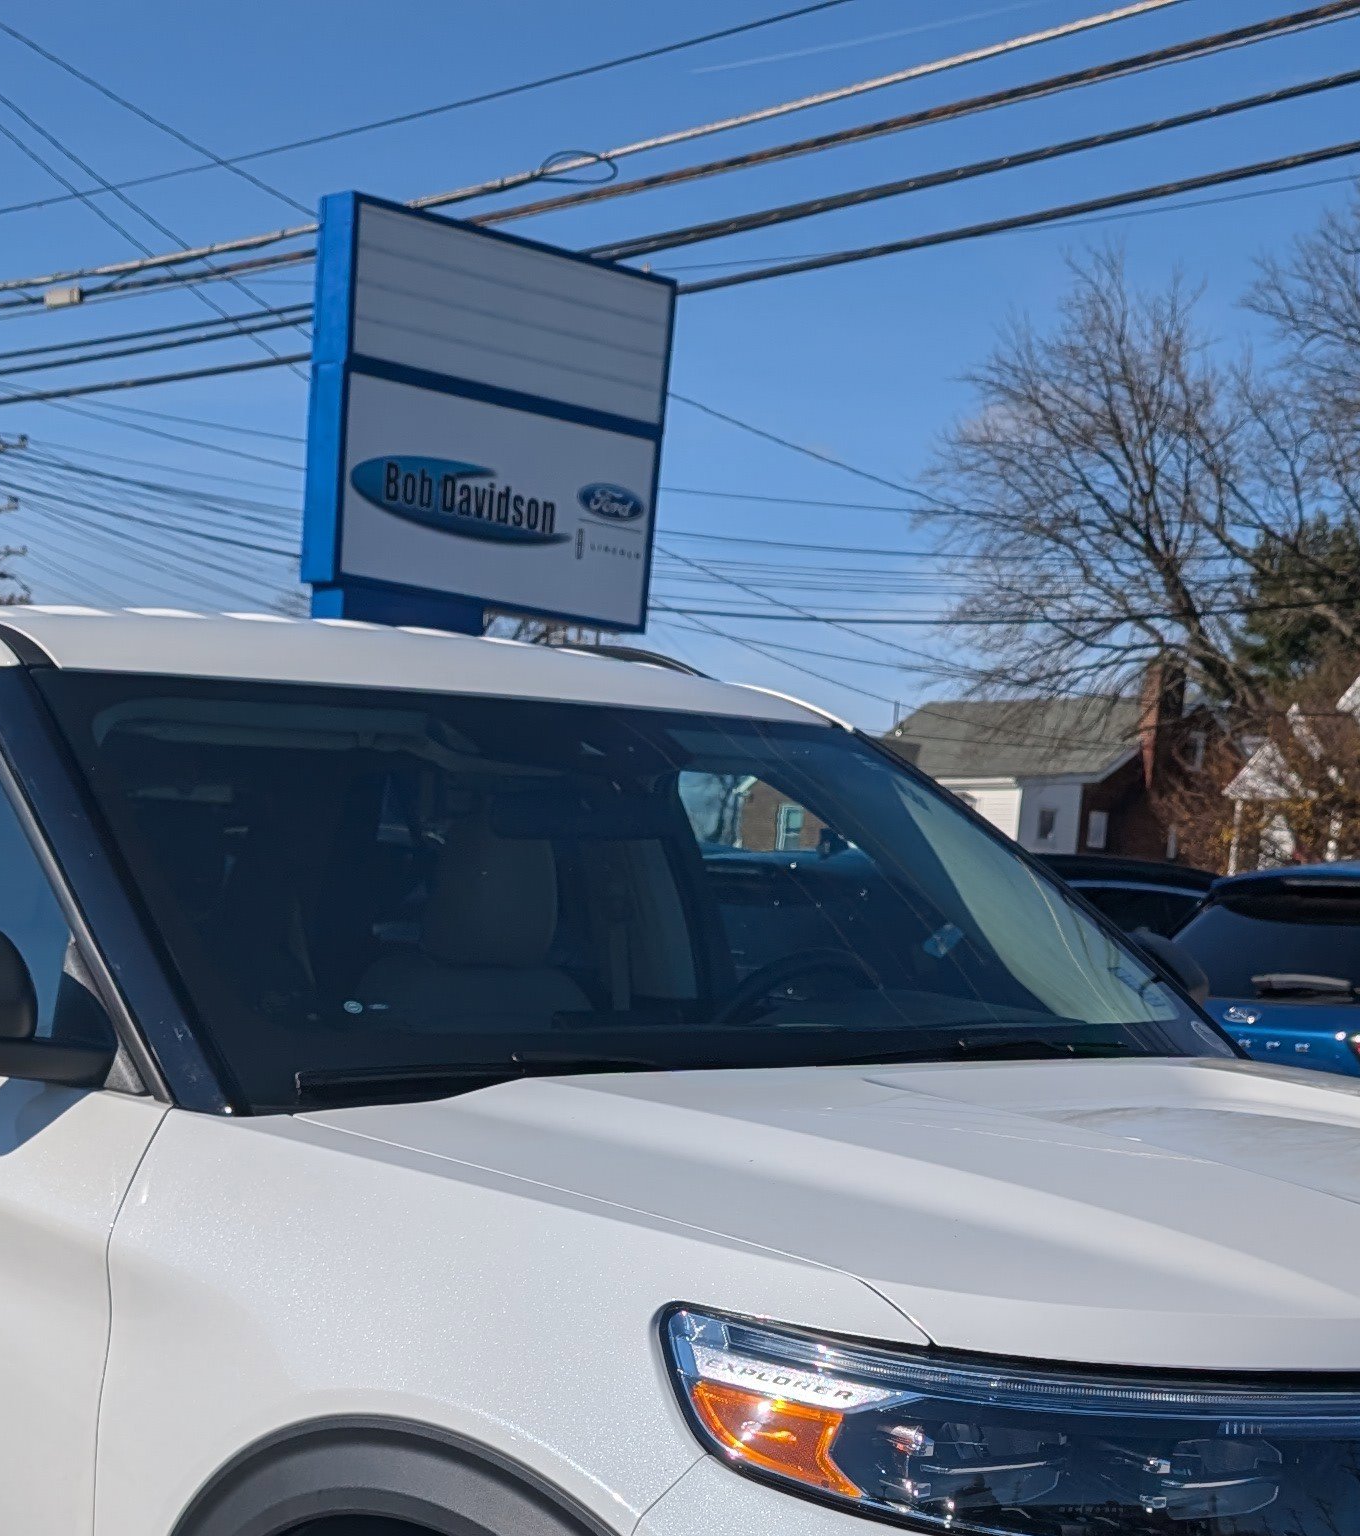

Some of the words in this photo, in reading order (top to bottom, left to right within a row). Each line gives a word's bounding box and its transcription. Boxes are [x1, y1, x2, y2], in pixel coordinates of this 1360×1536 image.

[386, 462, 433, 511] Bob
[442, 474, 556, 534] Davidson
[705, 1359, 854, 1401] EXPLORER
